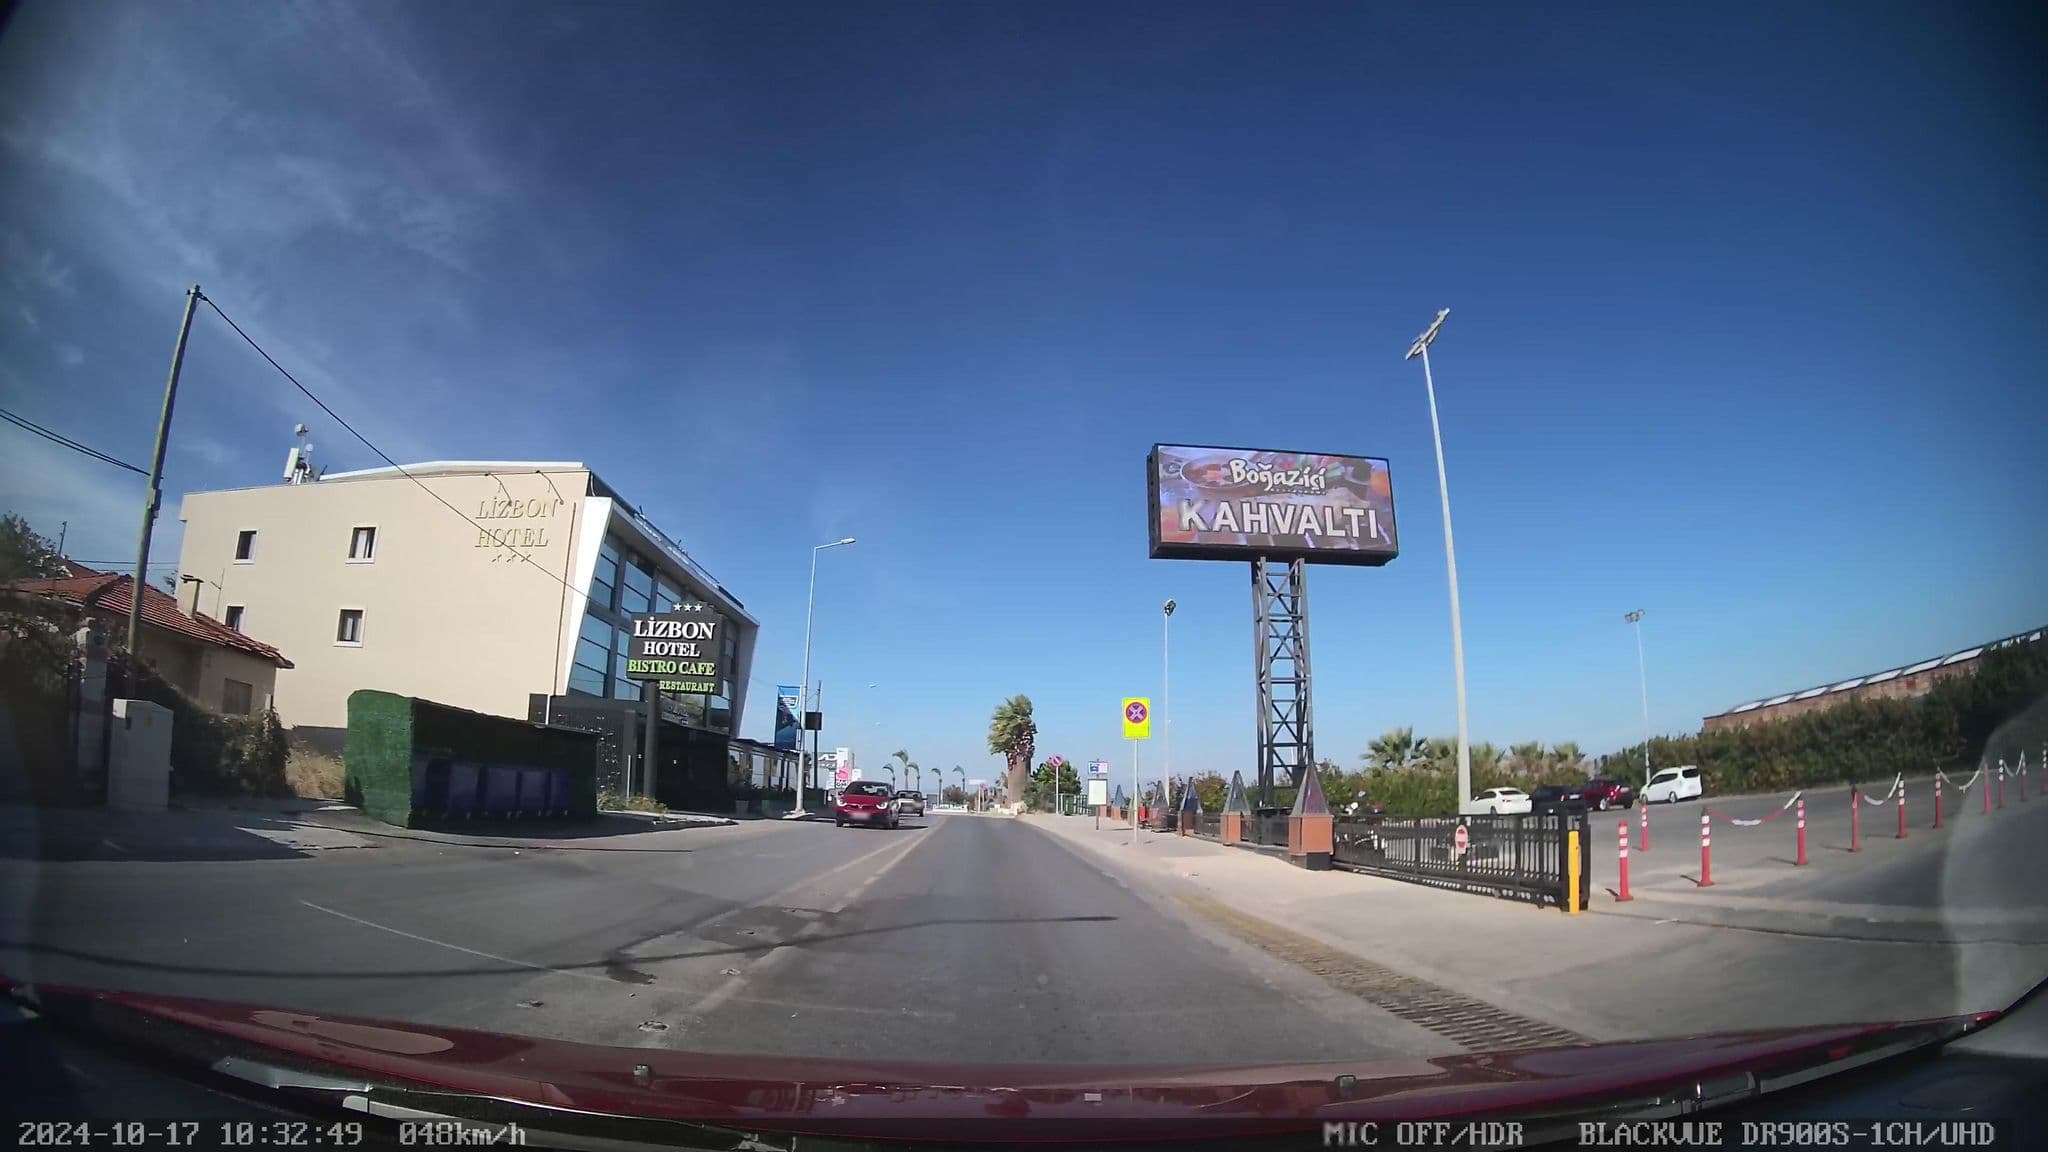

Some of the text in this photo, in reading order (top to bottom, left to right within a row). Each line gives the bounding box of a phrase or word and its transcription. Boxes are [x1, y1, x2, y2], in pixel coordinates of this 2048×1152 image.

[475, 497, 559, 519] LİZBON
[1179, 499, 1379, 539] KAHVALTI
[474, 528, 549, 548] HOTEL
[633, 616, 716, 640] LİZBON
[643, 641, 701, 657] HOTEL
[627, 659, 716, 676] BISTRO CAFE
[658, 680, 716, 693] RESTAURANT
